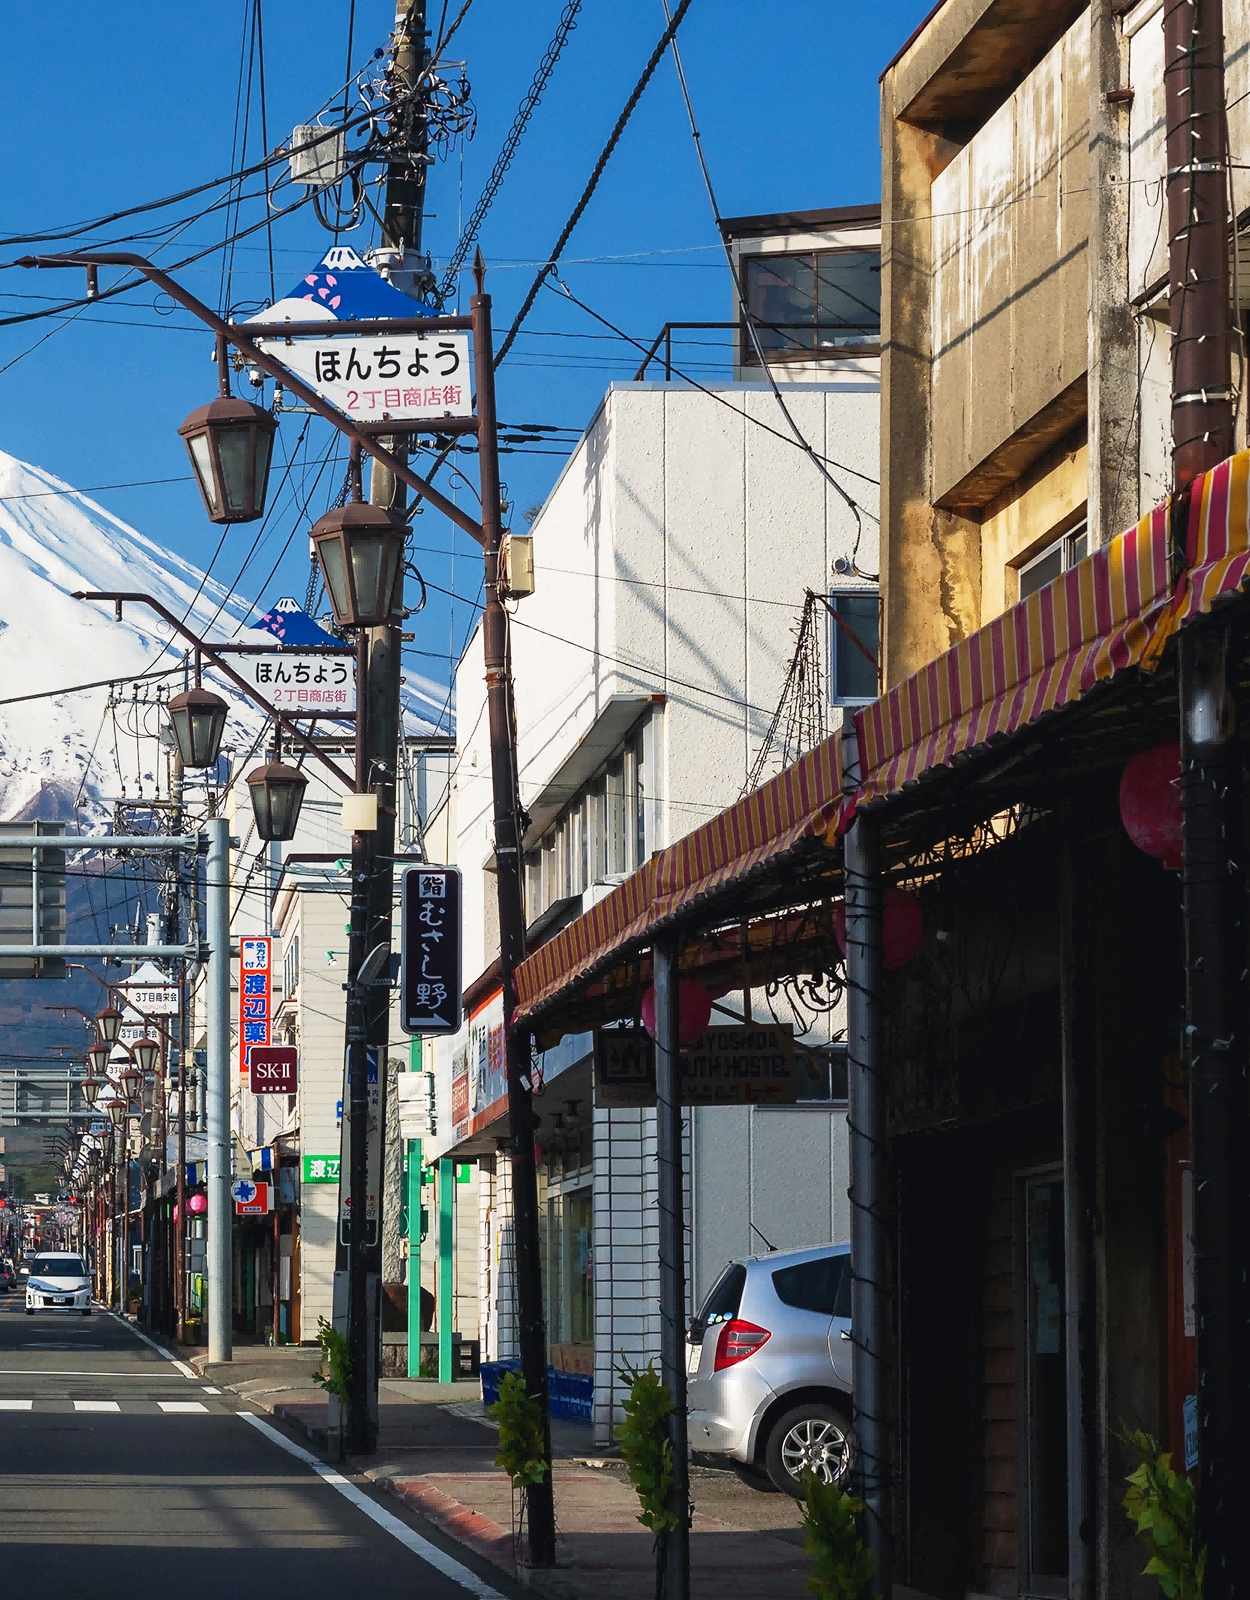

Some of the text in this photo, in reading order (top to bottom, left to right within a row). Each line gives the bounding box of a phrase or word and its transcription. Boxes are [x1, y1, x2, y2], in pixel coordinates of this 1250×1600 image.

[315, 342, 460, 382] ほんちょう
[346, 385, 462, 410] 2丁目商店街
[255, 661, 348, 685] ほんちょう
[273, 689, 347, 703] 2丁目商店街
[416, 900, 447, 1009] むさし野
[135, 992, 178, 1002] 3丁目商栄会
[256, 1062, 291, 1079] SK-II
